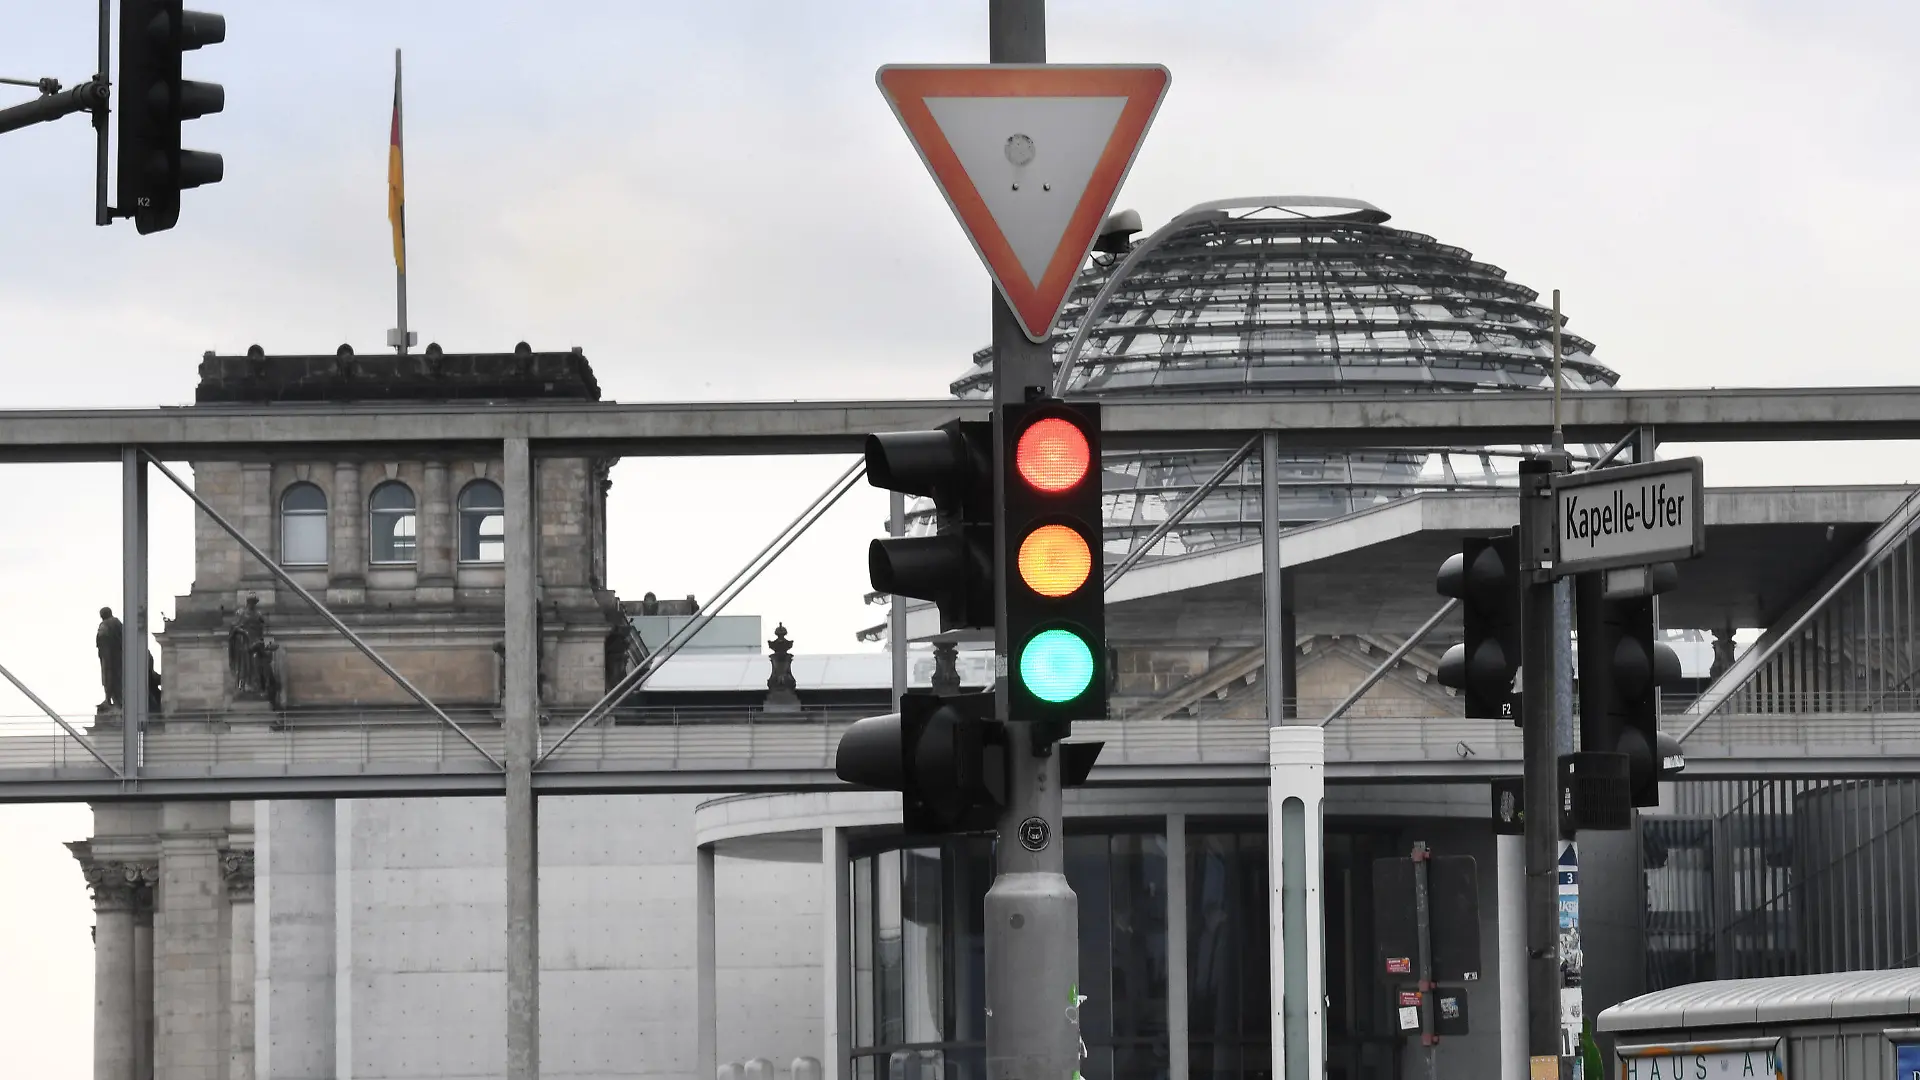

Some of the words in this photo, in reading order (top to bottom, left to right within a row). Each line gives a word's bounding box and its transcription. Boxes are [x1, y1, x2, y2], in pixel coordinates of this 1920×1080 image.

[137, 197, 150, 207] K2
[1566, 483, 1685, 548] Kapelle-Ufer
[1502, 703, 1511, 716] F2
[1567, 872, 1574, 884] 3
[1627, 1054, 1707, 1080] HAUS
